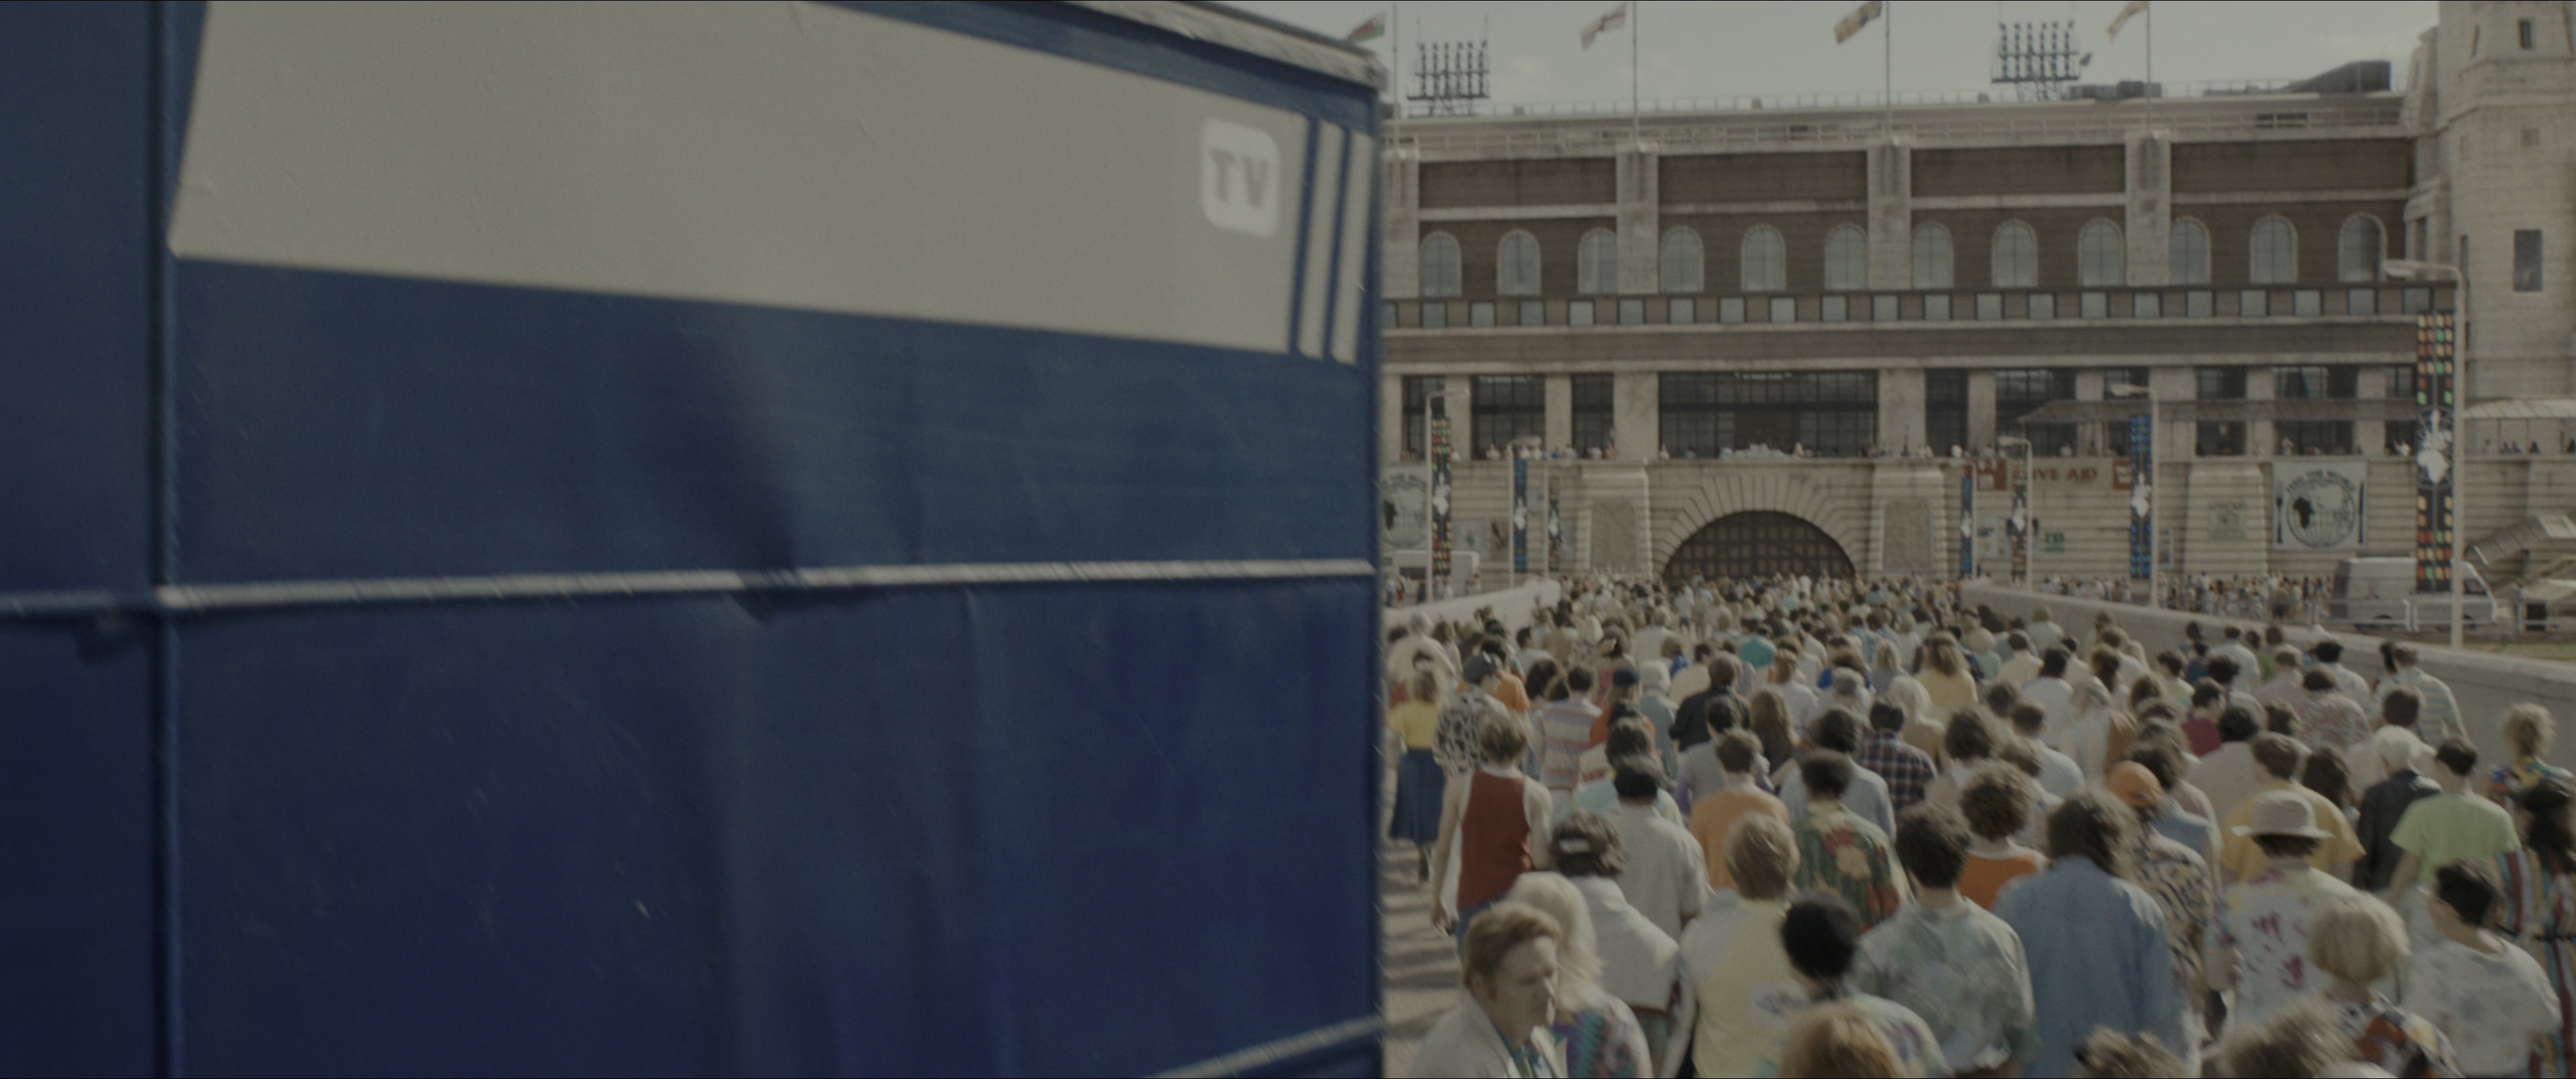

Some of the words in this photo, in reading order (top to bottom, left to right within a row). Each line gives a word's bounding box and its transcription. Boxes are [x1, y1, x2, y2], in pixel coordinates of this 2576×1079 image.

[1210, 147, 1270, 209] TV
[2032, 467, 2058, 481] IVE
[2066, 466, 2098, 481] AID
